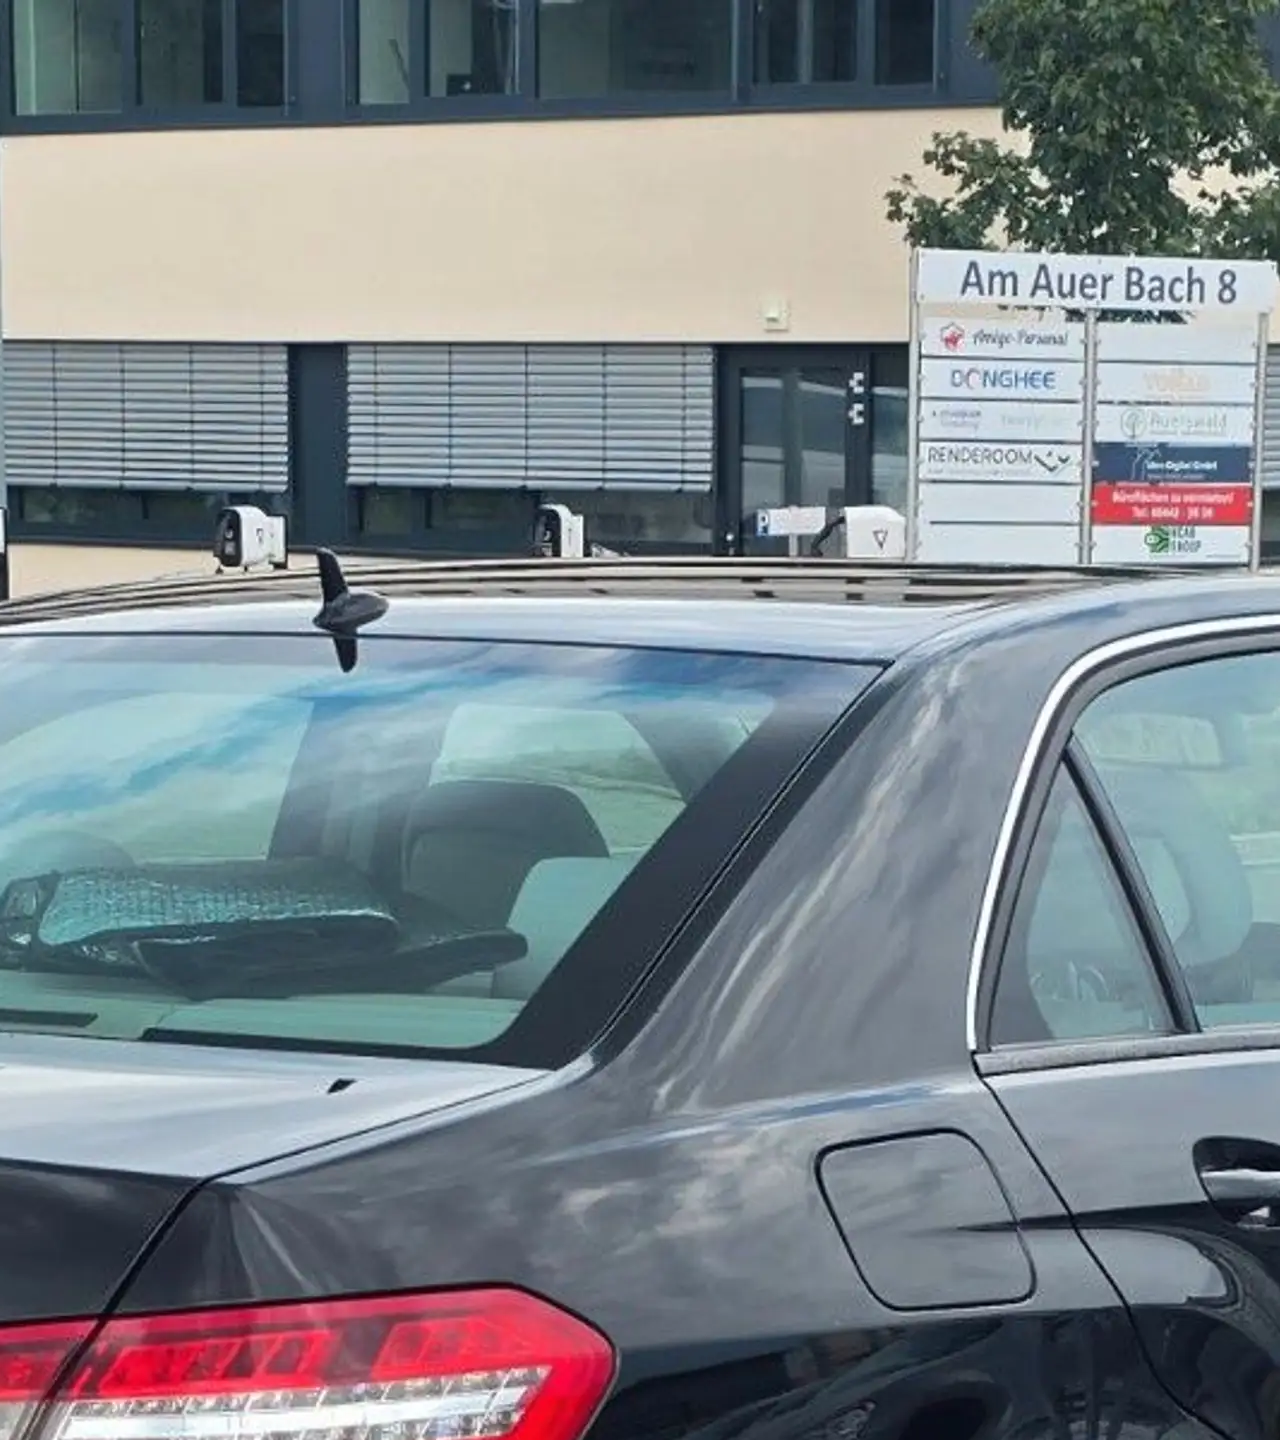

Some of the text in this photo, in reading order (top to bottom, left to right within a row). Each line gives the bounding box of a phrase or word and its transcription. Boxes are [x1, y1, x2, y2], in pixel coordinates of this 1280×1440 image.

[961, 260, 1237, 303] Am Auer Bach 8
[951, 368, 1055, 389] DONGHEE
[928, 446, 1033, 464] RENDEROOM
